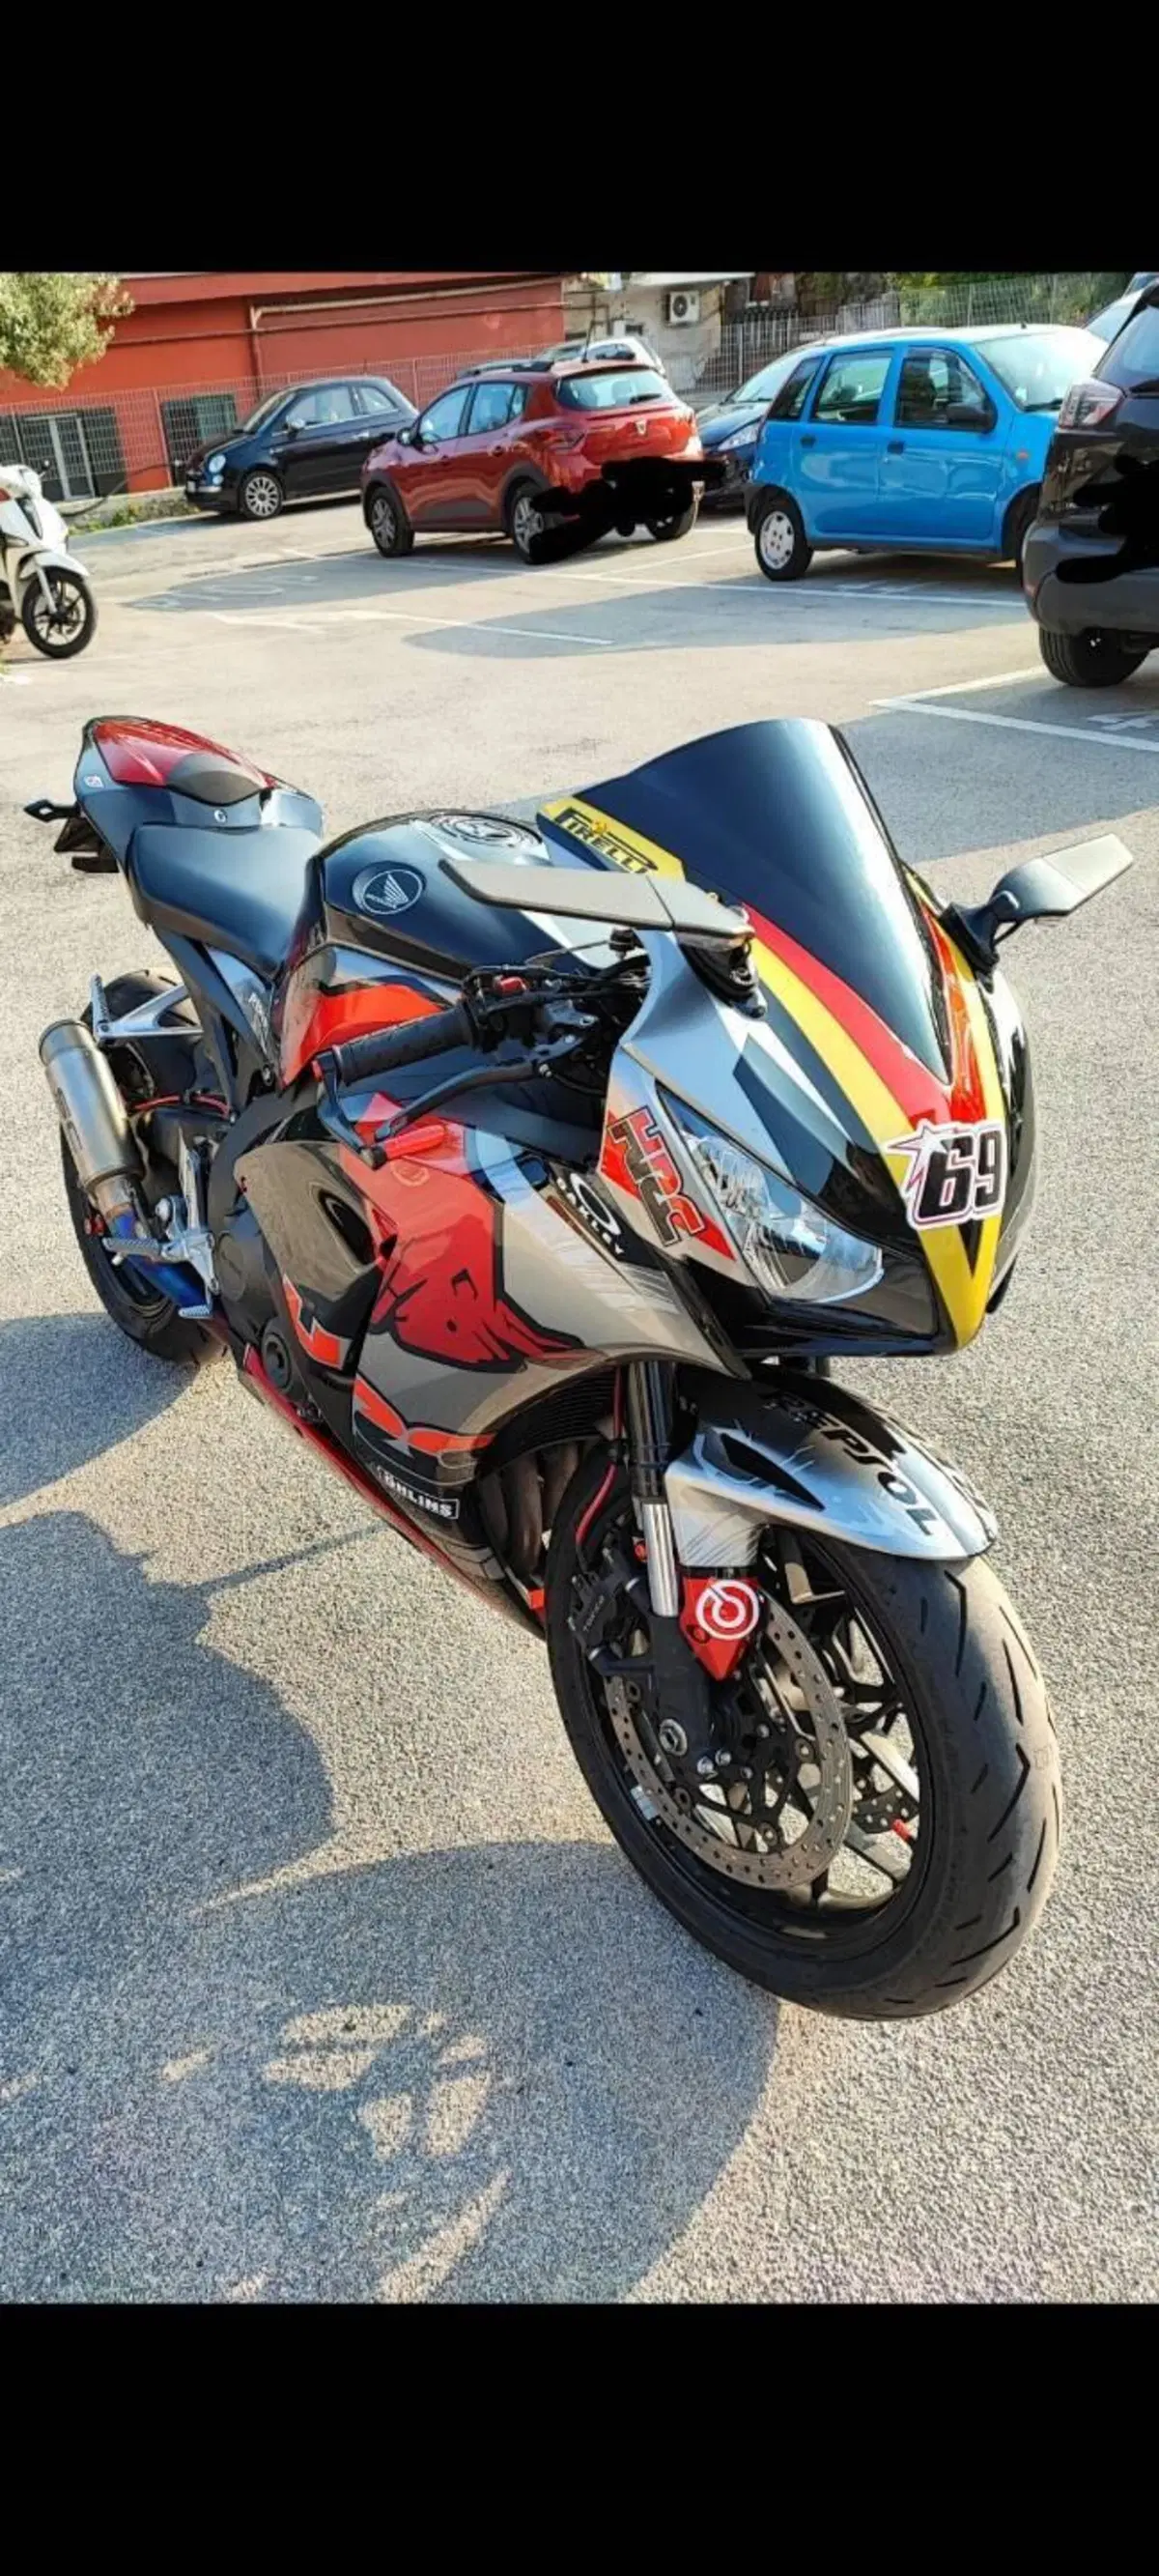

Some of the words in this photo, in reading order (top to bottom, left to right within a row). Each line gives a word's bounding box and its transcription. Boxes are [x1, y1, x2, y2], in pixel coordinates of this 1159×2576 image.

[554, 807, 659, 873] PIRELLI
[556, 1175, 625, 1254] OAKLEY
[607, 1105, 706, 1246] HRC
[918, 1129, 1003, 1219] 69
[758, 1391, 938, 1536] REPSOL
